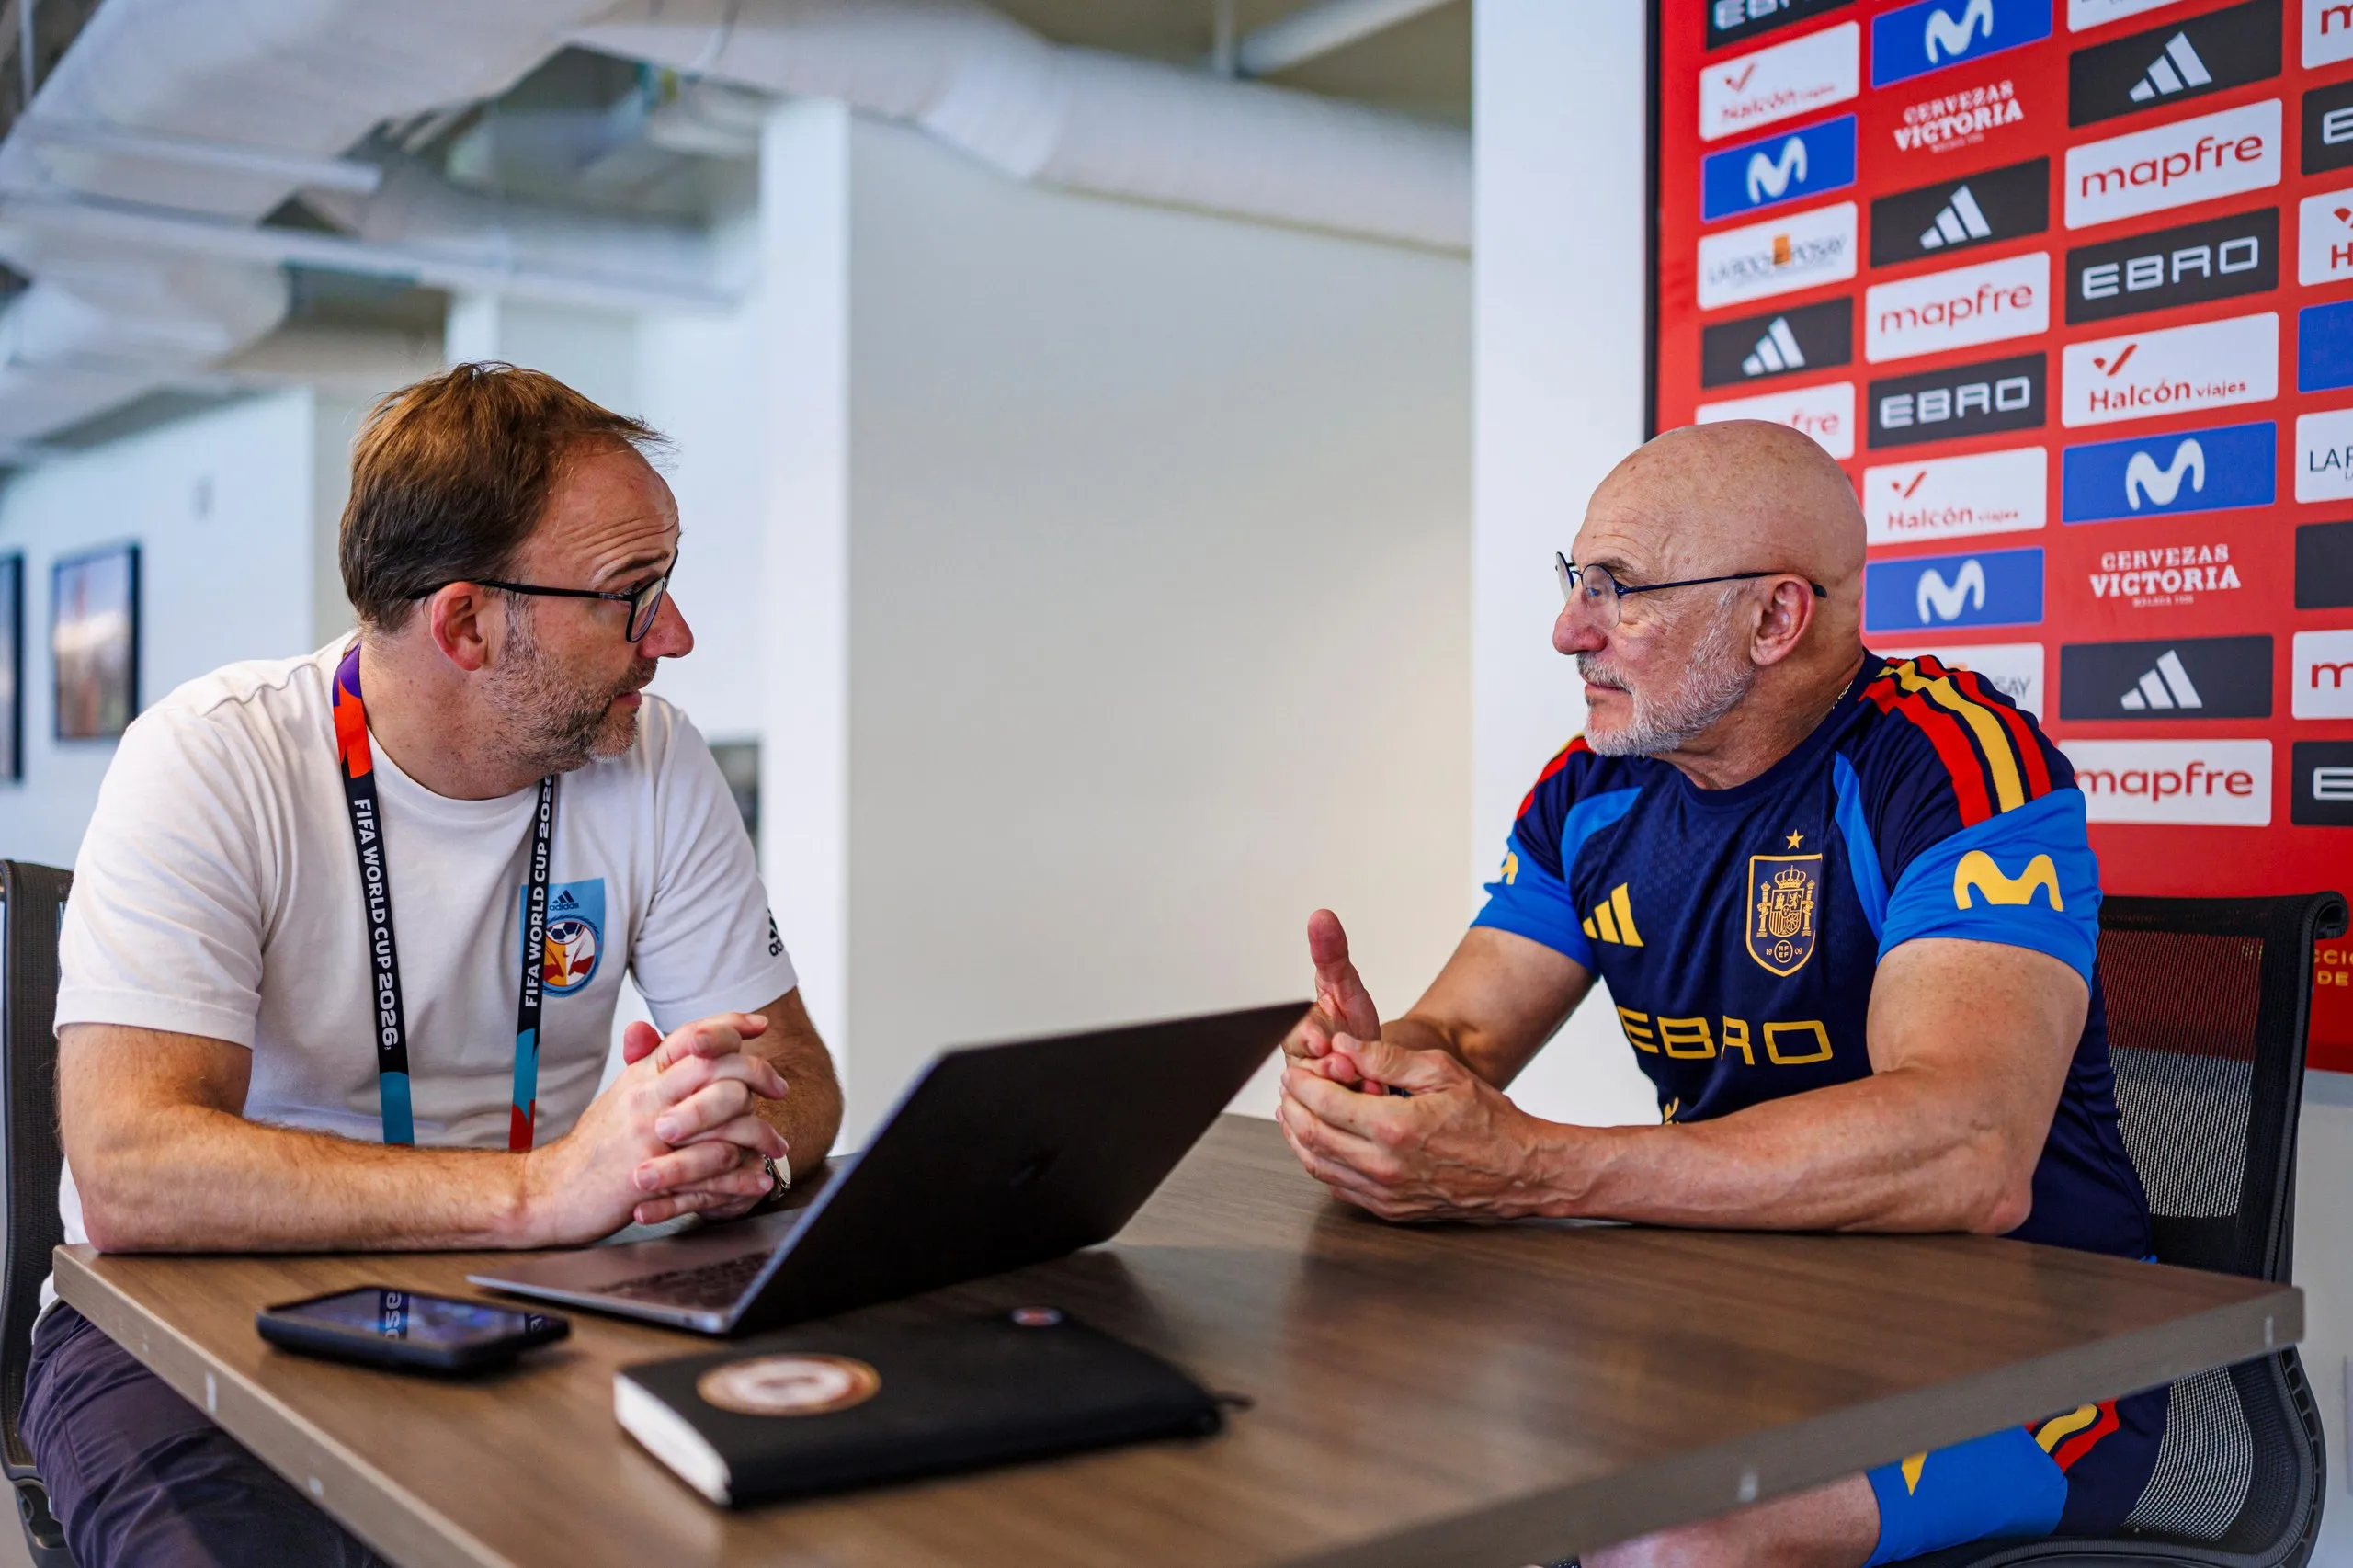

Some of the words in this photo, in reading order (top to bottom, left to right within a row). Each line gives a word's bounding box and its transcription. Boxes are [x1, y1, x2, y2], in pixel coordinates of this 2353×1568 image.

[1904, 80, 2014, 125] CERVEZAS
[1893, 98, 2025, 152] VICTORIA
[2081, 135, 2264, 198] mapfre
[2082, 235, 2259, 300] EBRO
[1880, 284, 2033, 333] mapfre
[1880, 376, 2030, 429] EBRO
[2090, 379, 2191, 412] Halcón
[2196, 381, 2246, 398] viajes
[1887, 506, 1972, 530] Halcón
[2101, 544, 2229, 572] CERVEZAS
[2089, 565, 2242, 598] VICTORIA
[2075, 760, 2255, 804] mapfre
[354, 799, 374, 845] FIFA
[534, 841, 547, 882] CUP
[363, 846, 386, 924] WORLD
[549, 902, 579, 911] adidas
[529, 886, 545, 960] WORLD
[370, 926, 392, 969] CUP
[525, 964, 540, 1007] FIFA
[2317, 971, 2349, 986] DE
[1616, 1005, 1834, 1065] EBRO
